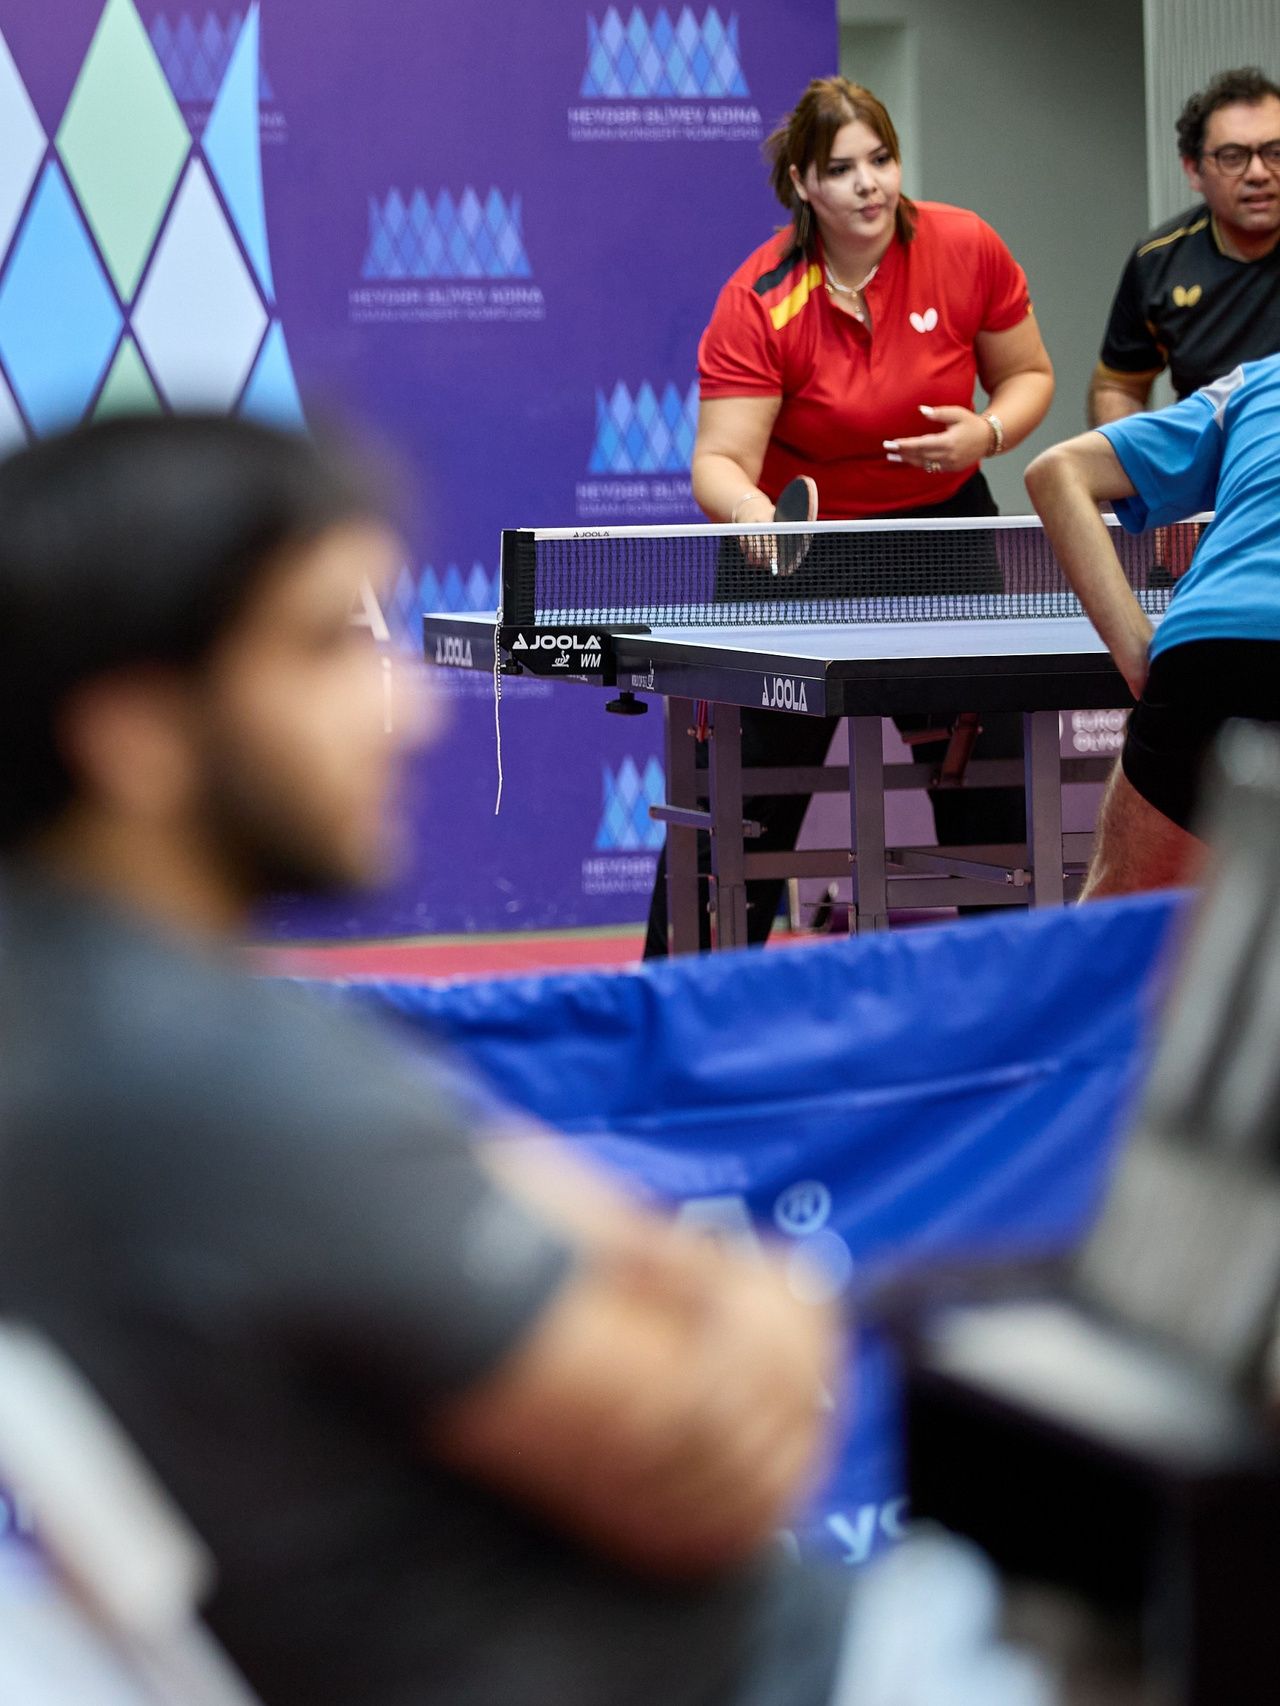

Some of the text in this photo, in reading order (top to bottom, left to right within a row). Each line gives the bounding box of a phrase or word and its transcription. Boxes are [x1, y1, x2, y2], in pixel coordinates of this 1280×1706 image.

[443, 637, 474, 667] JOOLA
[530, 635, 602, 650] JOOLA
[580, 653, 602, 668] WM
[770, 677, 808, 711] JOOLA
